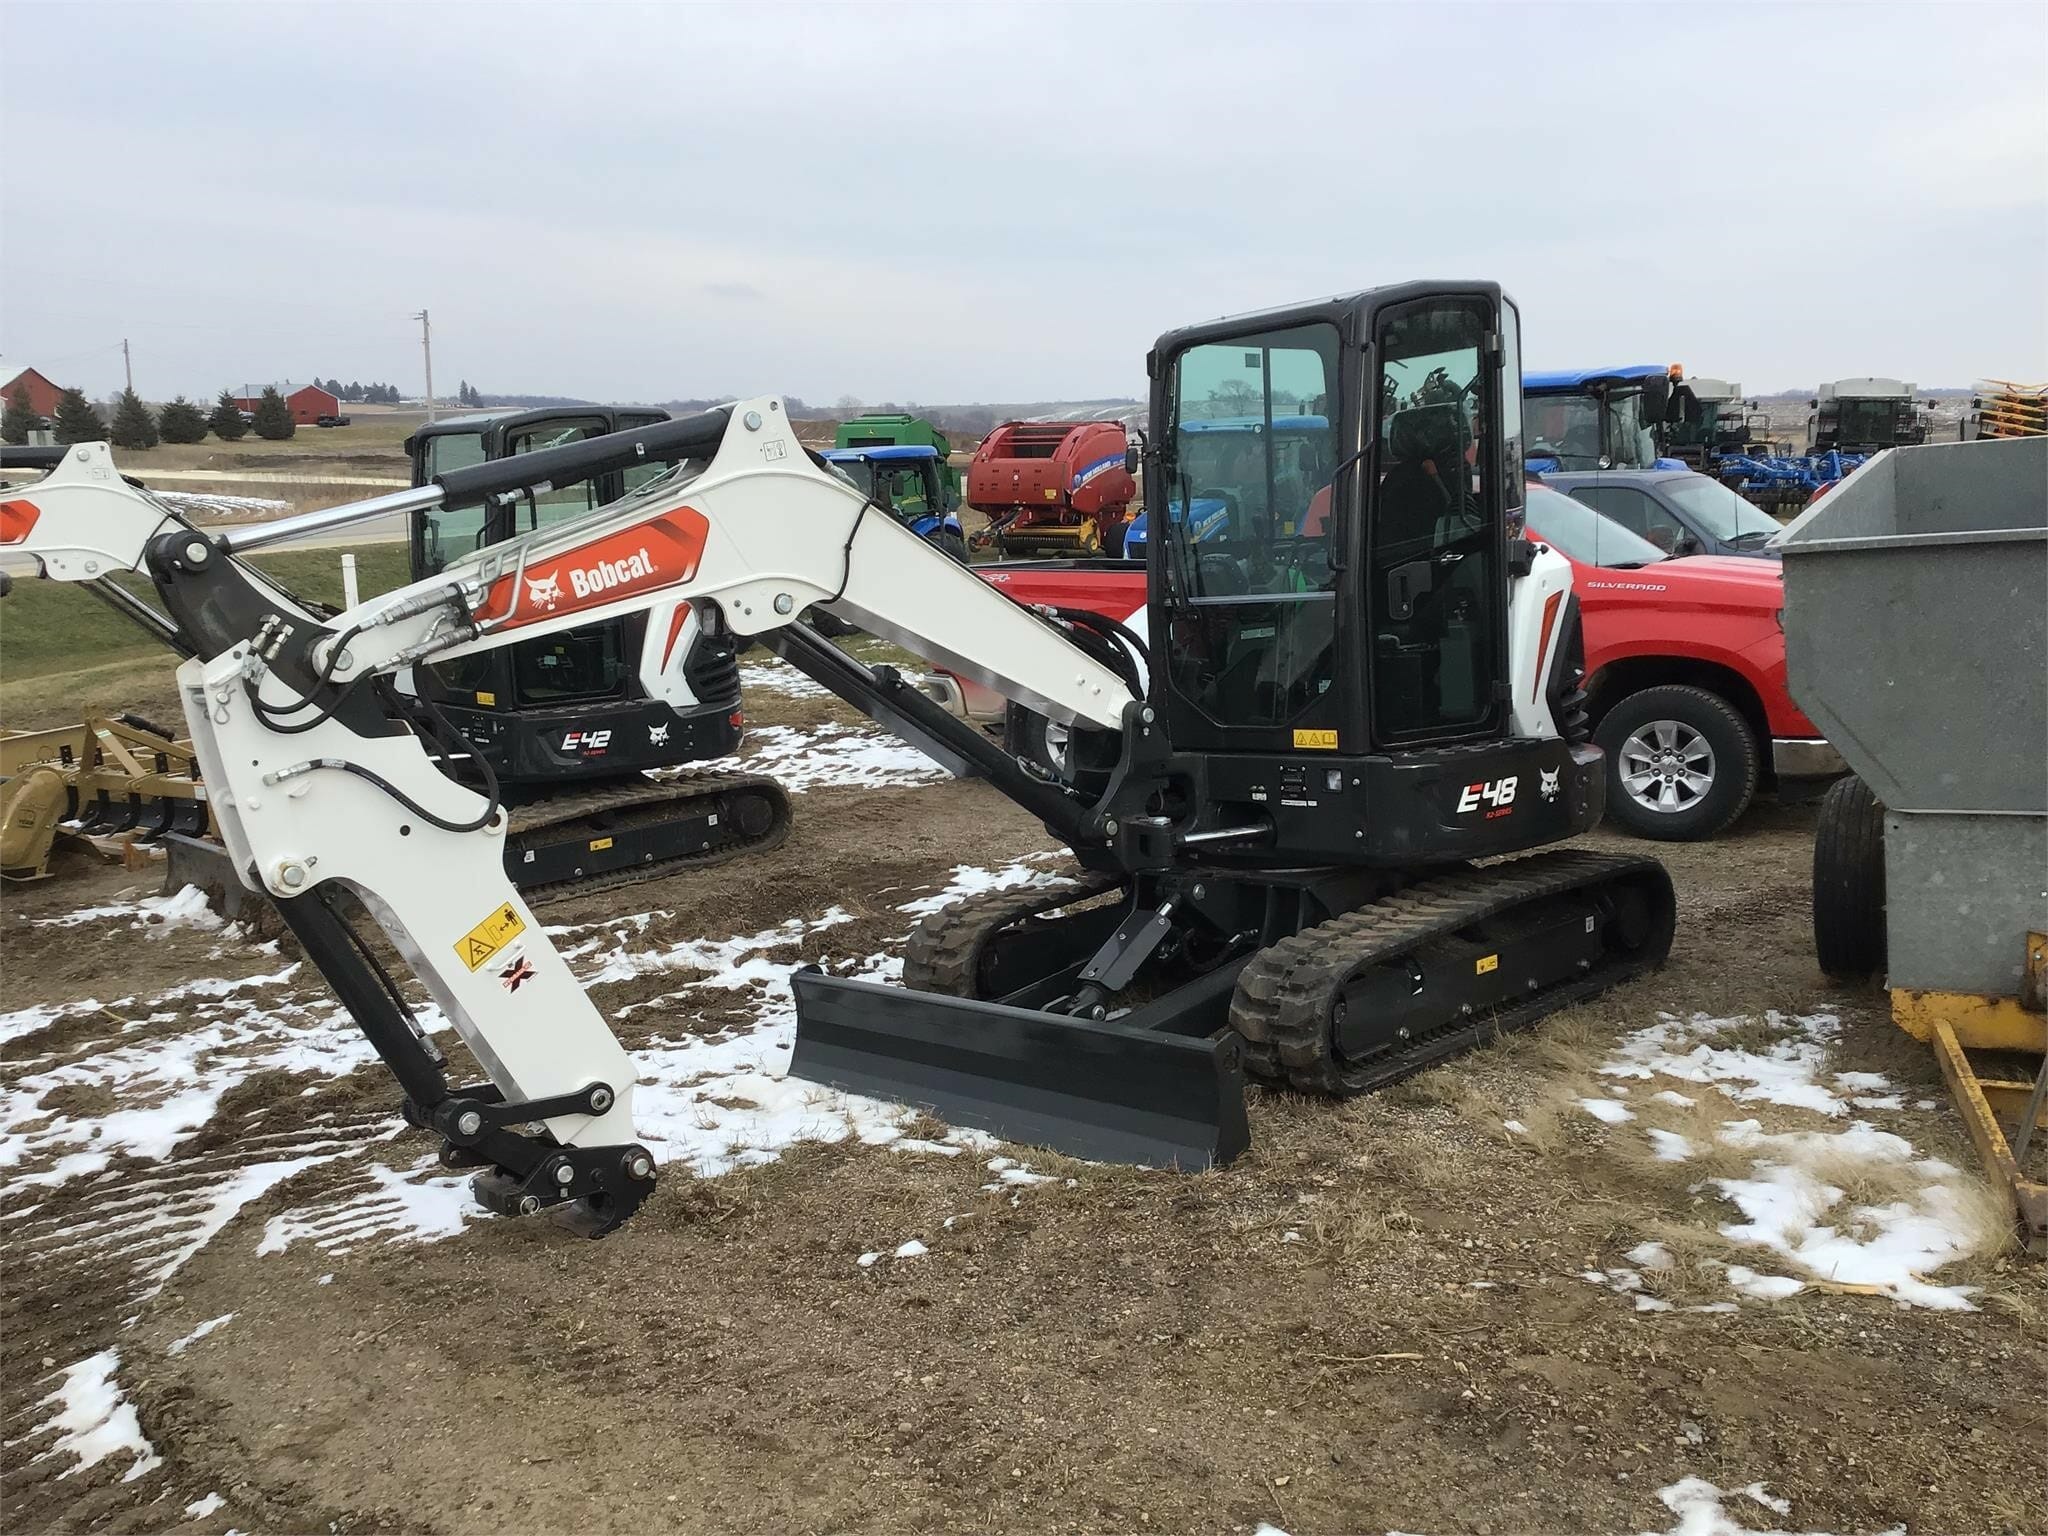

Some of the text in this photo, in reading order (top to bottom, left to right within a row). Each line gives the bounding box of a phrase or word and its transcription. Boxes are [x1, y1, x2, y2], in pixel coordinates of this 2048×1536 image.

[569, 547, 654, 599] Bobcat
[1587, 581, 1667, 591] SILVERADO
[560, 729, 612, 751] E42
[1456, 776, 1518, 814] E48
